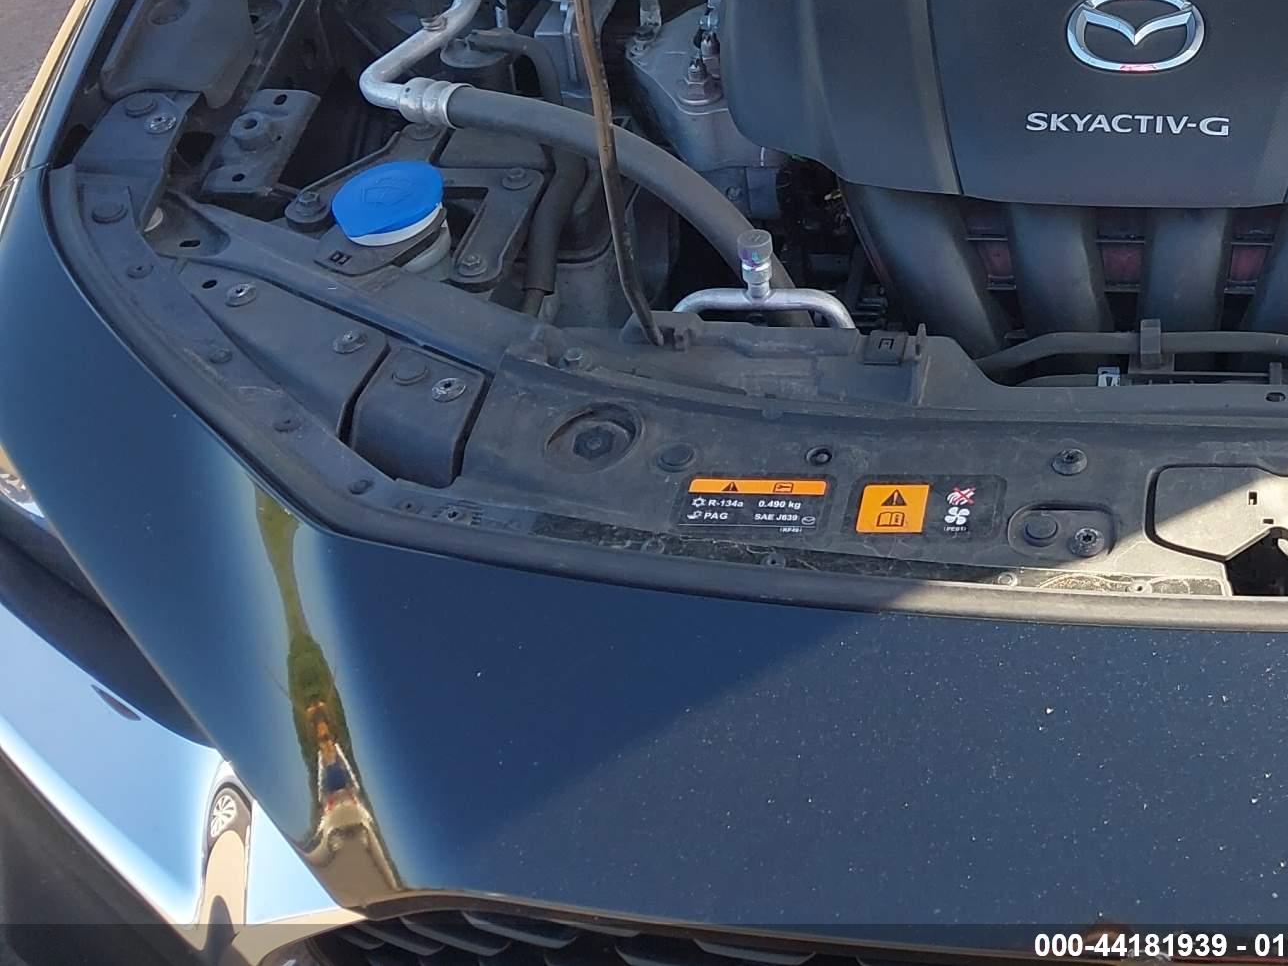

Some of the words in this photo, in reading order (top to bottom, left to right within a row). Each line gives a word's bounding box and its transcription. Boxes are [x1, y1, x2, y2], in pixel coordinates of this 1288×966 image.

[1026, 112, 1230, 136] SKYACTIV-G
[707, 499, 744, 508] R-134a
[758, 500, 786, 508] 0.490
[788, 500, 801, 510] kg
[703, 512, 728, 520] PAG
[754, 513, 774, 521] SAE
